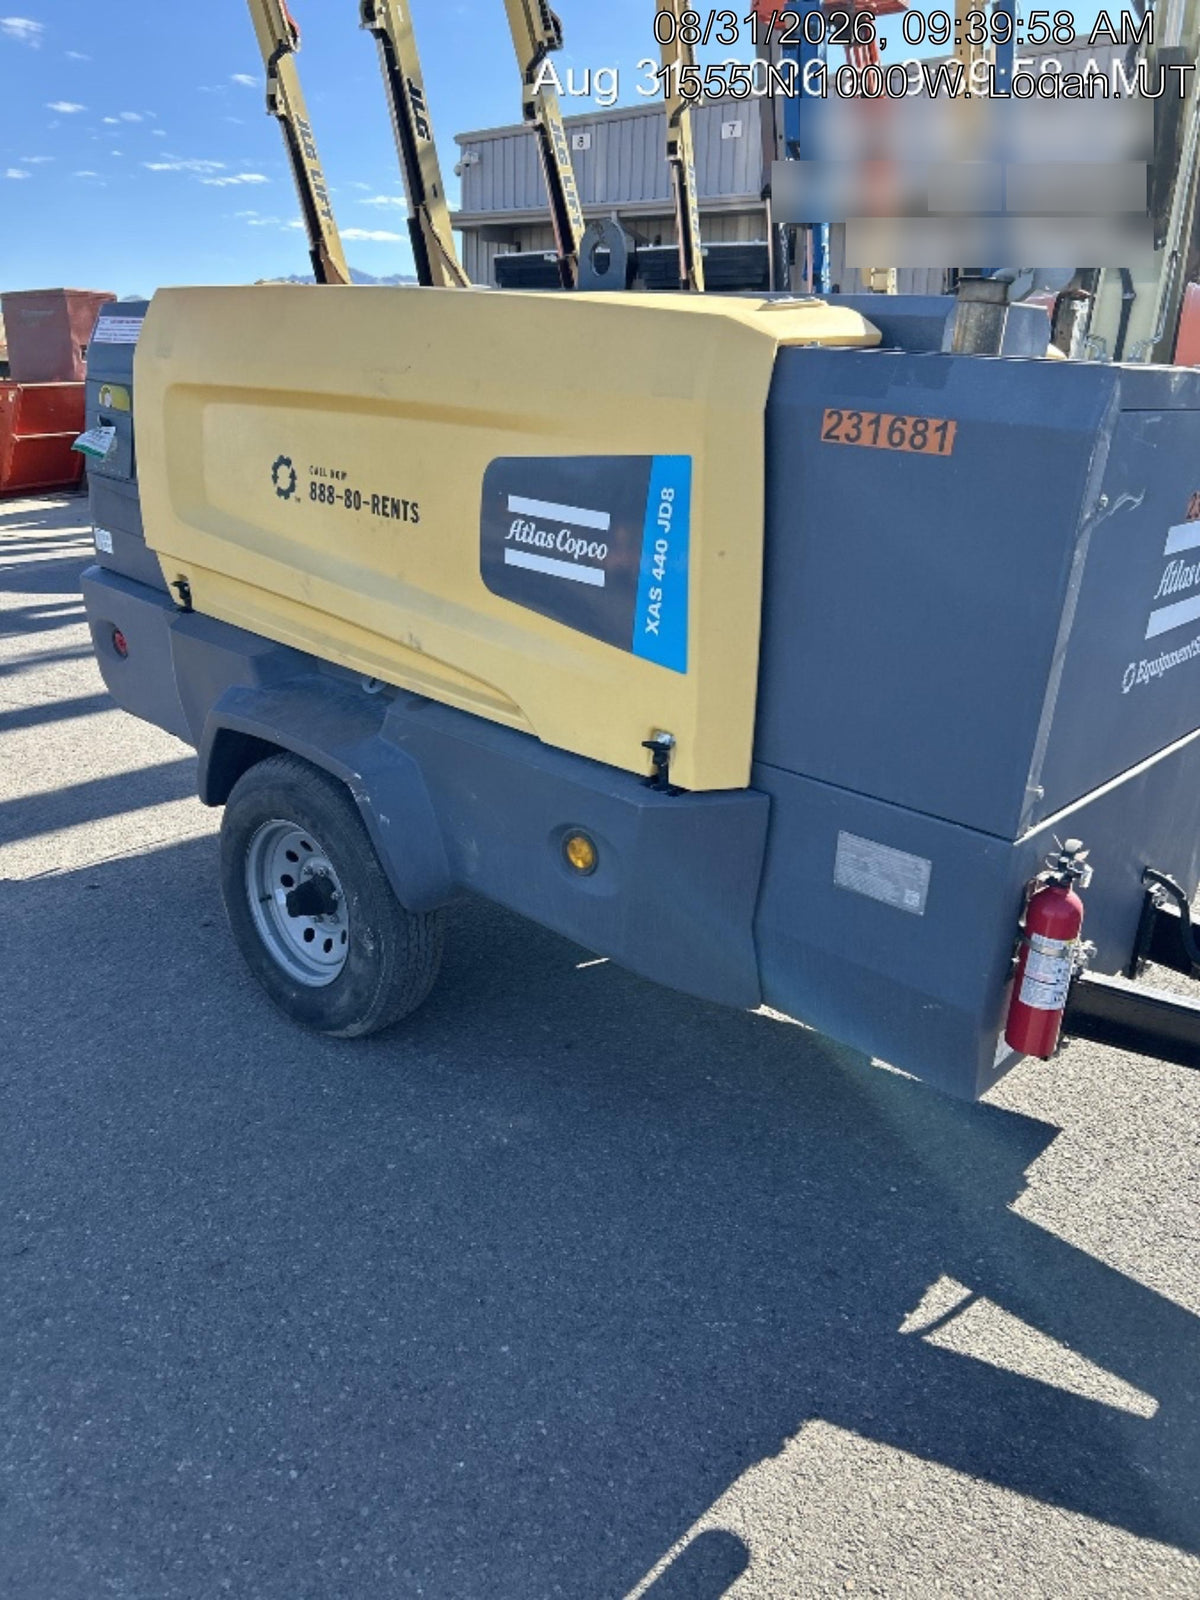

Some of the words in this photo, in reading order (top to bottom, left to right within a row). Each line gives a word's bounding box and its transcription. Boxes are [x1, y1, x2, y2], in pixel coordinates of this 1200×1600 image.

[404, 76, 432, 142] JLG
[823, 410, 949, 453] 231681
[309, 481, 421, 524] 888-80-RENTS
[657, 486, 676, 534] JD8
[504, 518, 556, 549] Atlas
[556, 528, 609, 561] Copco
[652, 538, 669, 582] 440
[644, 586, 663, 636] XAS
